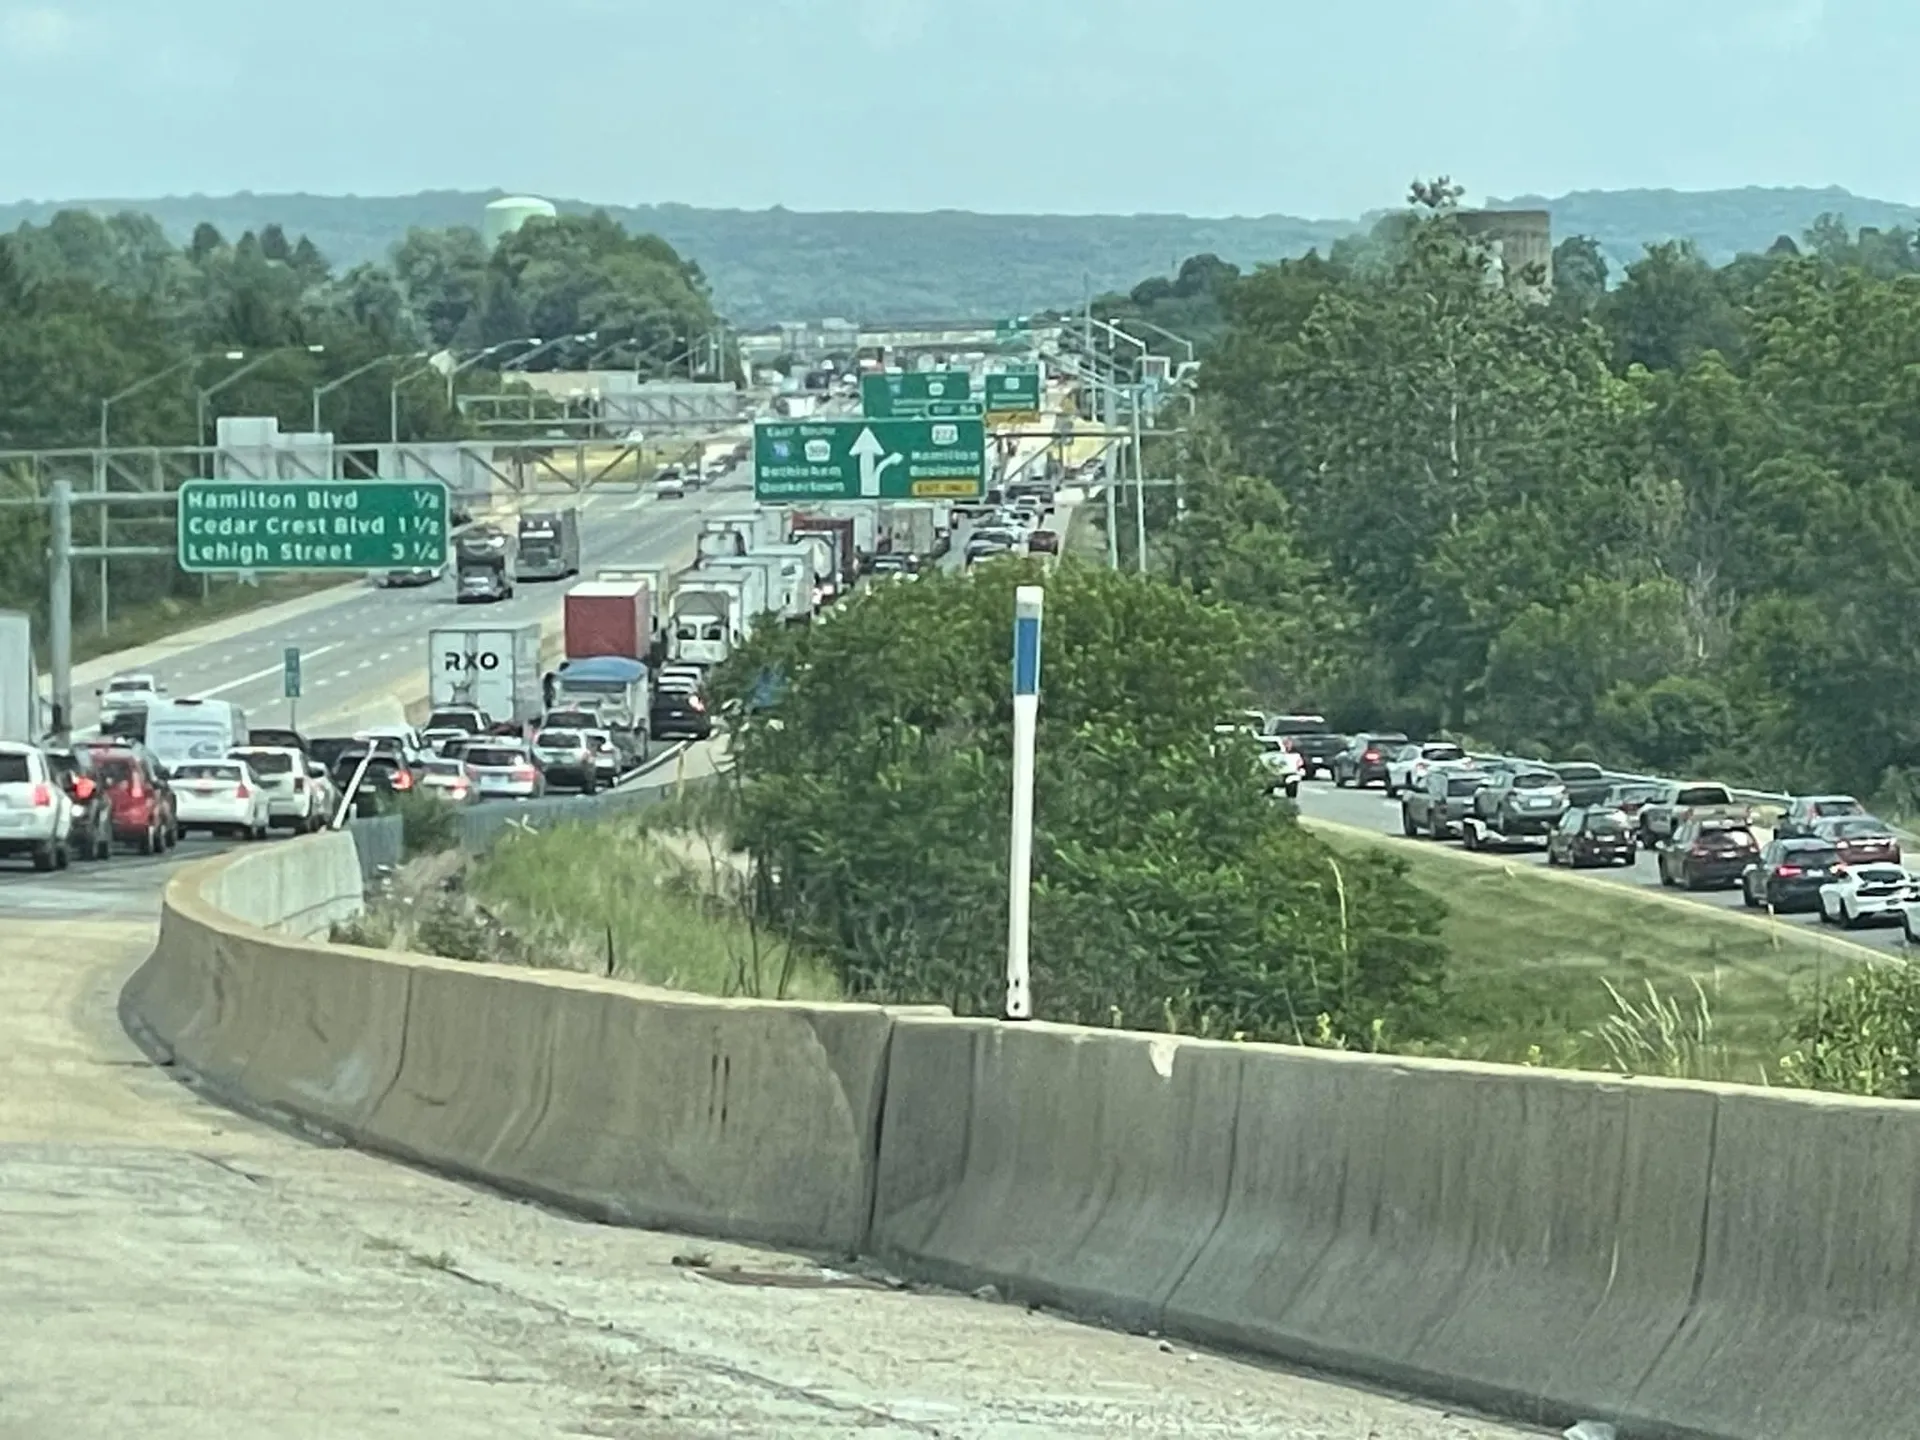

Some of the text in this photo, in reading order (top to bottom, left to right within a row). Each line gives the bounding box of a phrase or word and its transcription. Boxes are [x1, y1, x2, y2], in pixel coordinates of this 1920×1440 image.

[188, 490, 297, 509] Hamilton
[307, 490, 359, 509] Blvd
[188, 516, 258, 535] Cedar
[266, 516, 327, 535] Crest
[334, 516, 385, 535] Blvd
[188, 542, 269, 565] Lehigh
[280, 543, 353, 561] Street
[445, 651, 499, 671] RXO
